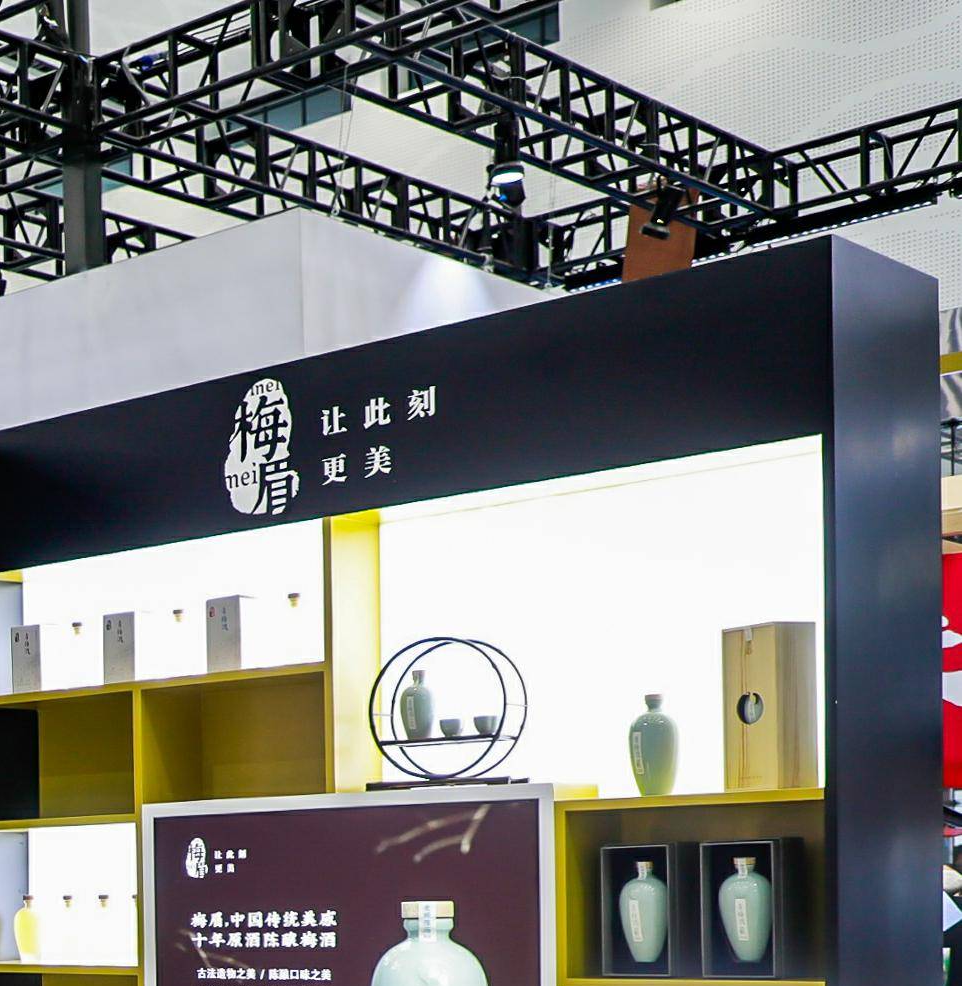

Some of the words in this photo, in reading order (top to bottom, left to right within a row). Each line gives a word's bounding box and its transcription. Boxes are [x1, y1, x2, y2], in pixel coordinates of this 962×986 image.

[320, 385, 437, 436] 让此刻
[225, 461, 258, 490] mei
[321, 445, 393, 486] 更美
[189, 931, 337, 949] 十年原酒陈酿梅酒
